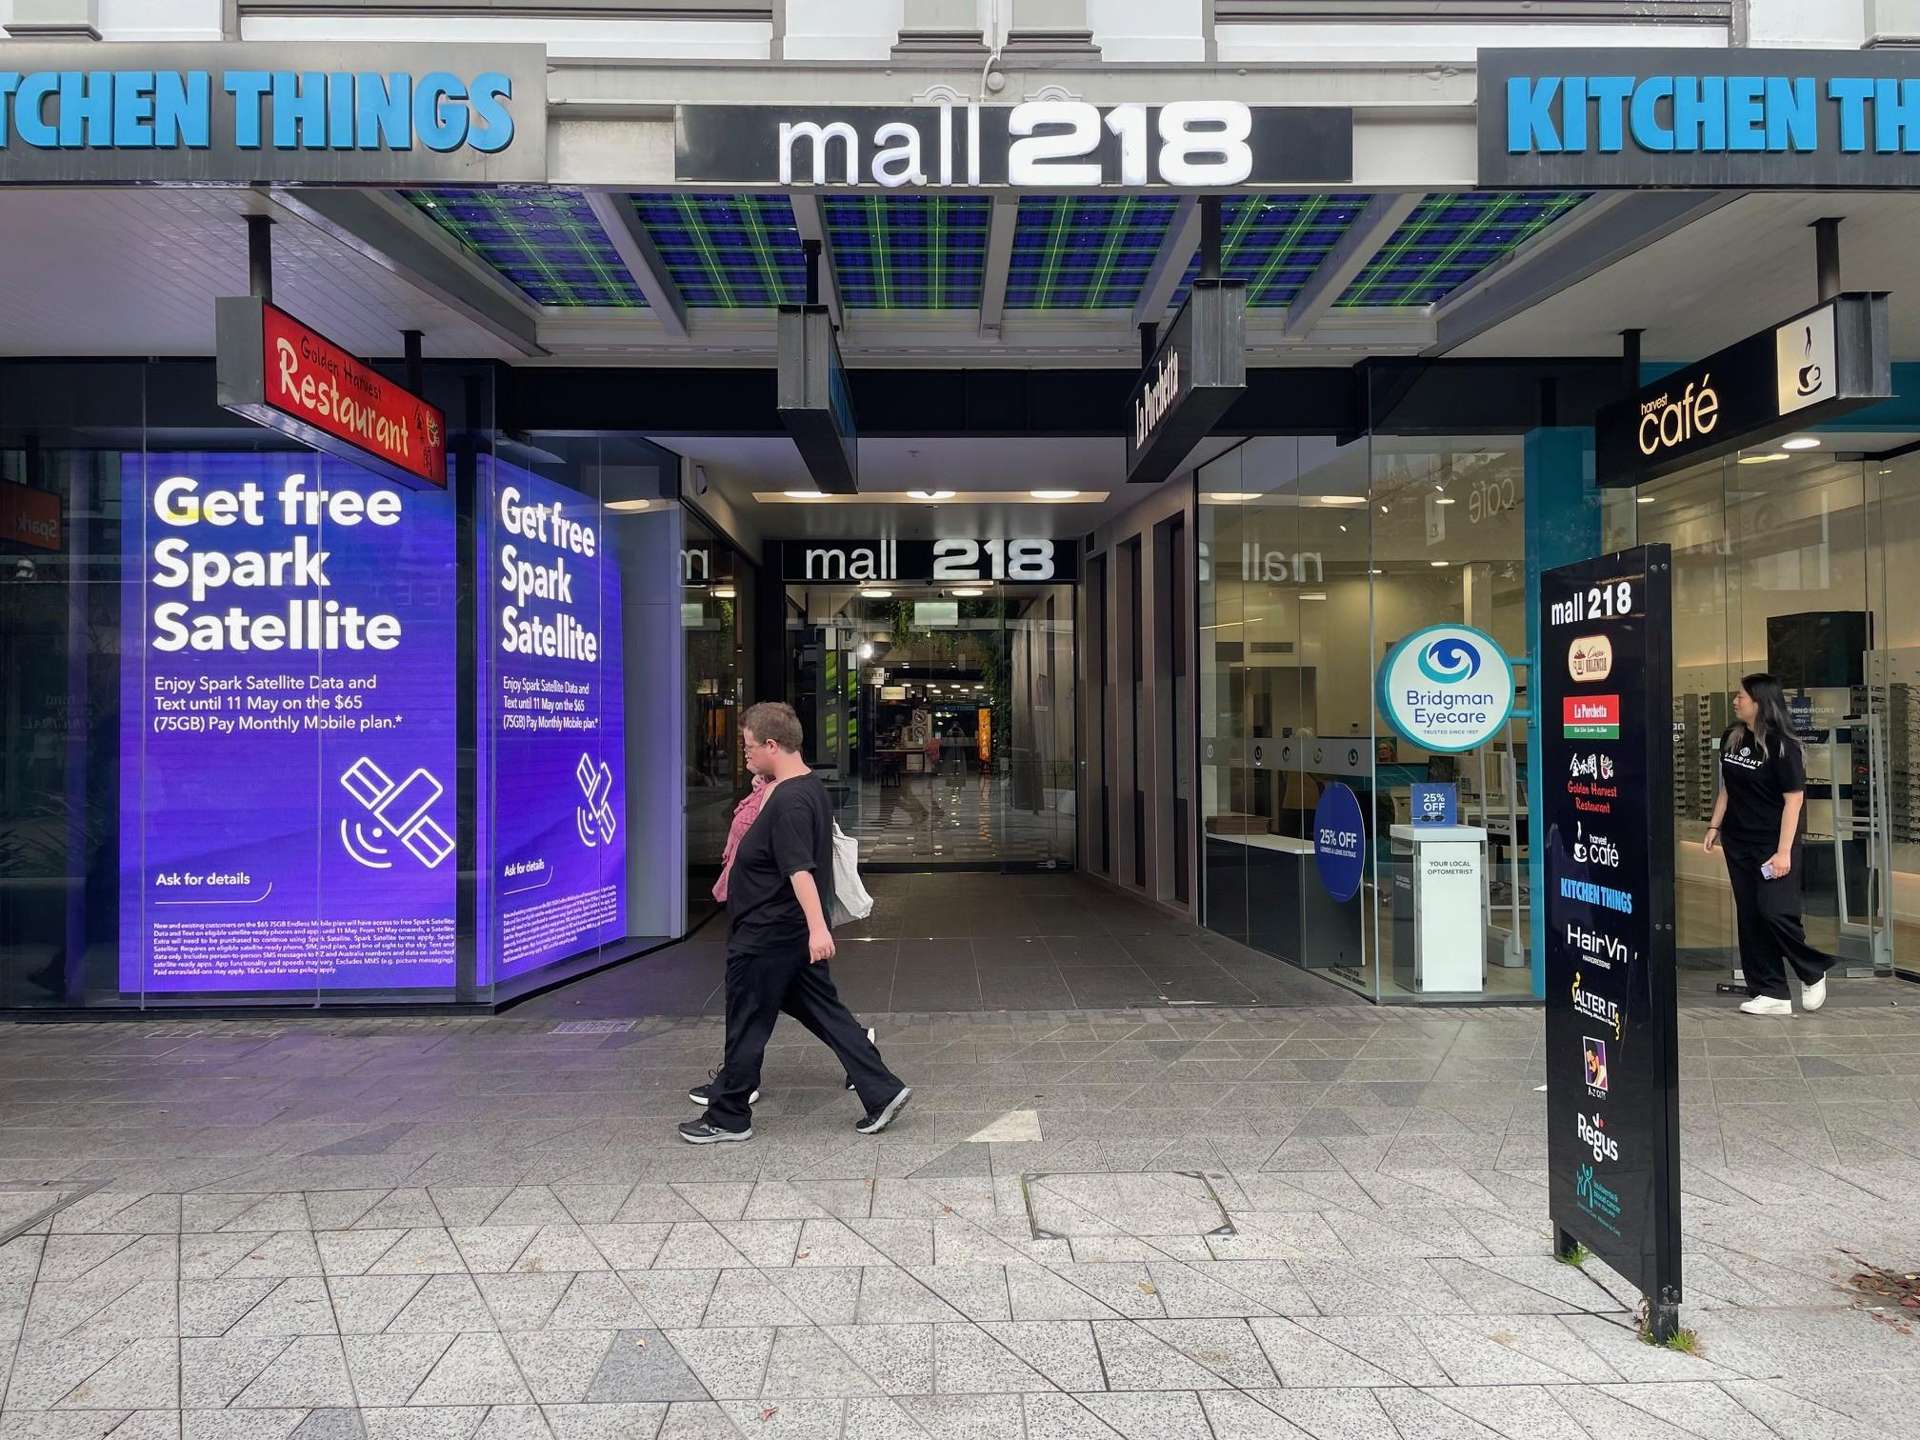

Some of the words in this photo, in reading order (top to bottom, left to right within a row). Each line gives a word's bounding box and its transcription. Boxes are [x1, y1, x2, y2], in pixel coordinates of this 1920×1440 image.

[224, 70, 514, 153] THINGS
[1507, 75, 1817, 154] KITCHEN
[1828, 76, 1920, 154] TH
[778, 101, 980, 188] mall
[1008, 100, 1253, 187] 218
[300, 336, 340, 376] Golden
[343, 361, 382, 401] Harvest
[276, 337, 410, 457] Restaurant
[1641, 392, 1668, 415] harvest
[1639, 373, 1718, 455] café
[154, 476, 264, 526] Get
[278, 474, 402, 526] free
[501, 486, 547, 543] Get
[551, 502, 596, 558] free
[152, 535, 331, 601] Spark
[804, 539, 898, 580] mall
[932, 538, 1056, 581] 218
[501, 544, 573, 607] Spark
[1551, 592, 1584, 626] mall
[1587, 581, 1632, 620] 218
[151, 599, 402, 651] Satellite
[501, 605, 597, 663] Satellite
[154, 676, 195, 694] Enjoy
[199, 676, 242, 693] Spark
[246, 675, 305, 690] Satellite
[309, 675, 344, 689] Data
[348, 675, 377, 689] and
[503, 676, 522, 692] Enjoy
[522, 678, 541, 693] Spark
[541, 679, 563, 693] Satellite
[565, 681, 578, 694] Data
[578, 682, 590, 695] and
[154, 696, 186, 710] Text
[189, 696, 221, 710] until
[227, 696, 241, 710] 11
[247, 696, 279, 713] May
[282, 699, 302, 710] on
[305, 695, 330, 709] the
[334, 694, 362, 710] $65
[503, 695, 517, 709] Text
[518, 696, 532, 709] until
[533, 697, 540, 710] 11
[541, 697, 554, 713] May
[555, 701, 563, 711] on
[563, 699, 573, 711] the
[574, 699, 585, 713] $65
[1406, 690, 1494, 710] Bridgman
[153, 716, 205, 733] (75GB)
[209, 716, 234, 734] Pay
[239, 715, 300, 733] Monthly
[304, 715, 356, 730] Mobile
[503, 714, 526, 731] (75GB)
[526, 715, 537, 731] Pay
[538, 715, 562, 731] Monthly
[563, 716, 582, 729] Mobile
[1414, 708, 1487, 728] Eyecare
[1423, 793, 1445, 803] 25%
[1567, 780, 1589, 795] Golden
[1591, 784, 1617, 798] Harvest
[1423, 802, 1445, 812] OFF
[1575, 797, 1611, 814] Restaurant
[1319, 828, 1337, 847] 25%
[1338, 831, 1357, 849] OFF
[1589, 834, 1608, 846] harvest
[504, 862, 517, 877] Ask
[517, 861, 526, 875] for
[526, 859, 545, 872] details
[1589, 843, 1620, 868] café
[155, 872, 181, 886] Ask
[184, 872, 203, 886] for
[206, 872, 251, 885] details
[1561, 877, 1600, 906] KITCHEN
[1600, 885, 1633, 915] THINGS
[1574, 988, 1606, 1016] ALTER
[1607, 1001, 1618, 1020] IT
[1577, 1112, 1619, 1163] Regus
